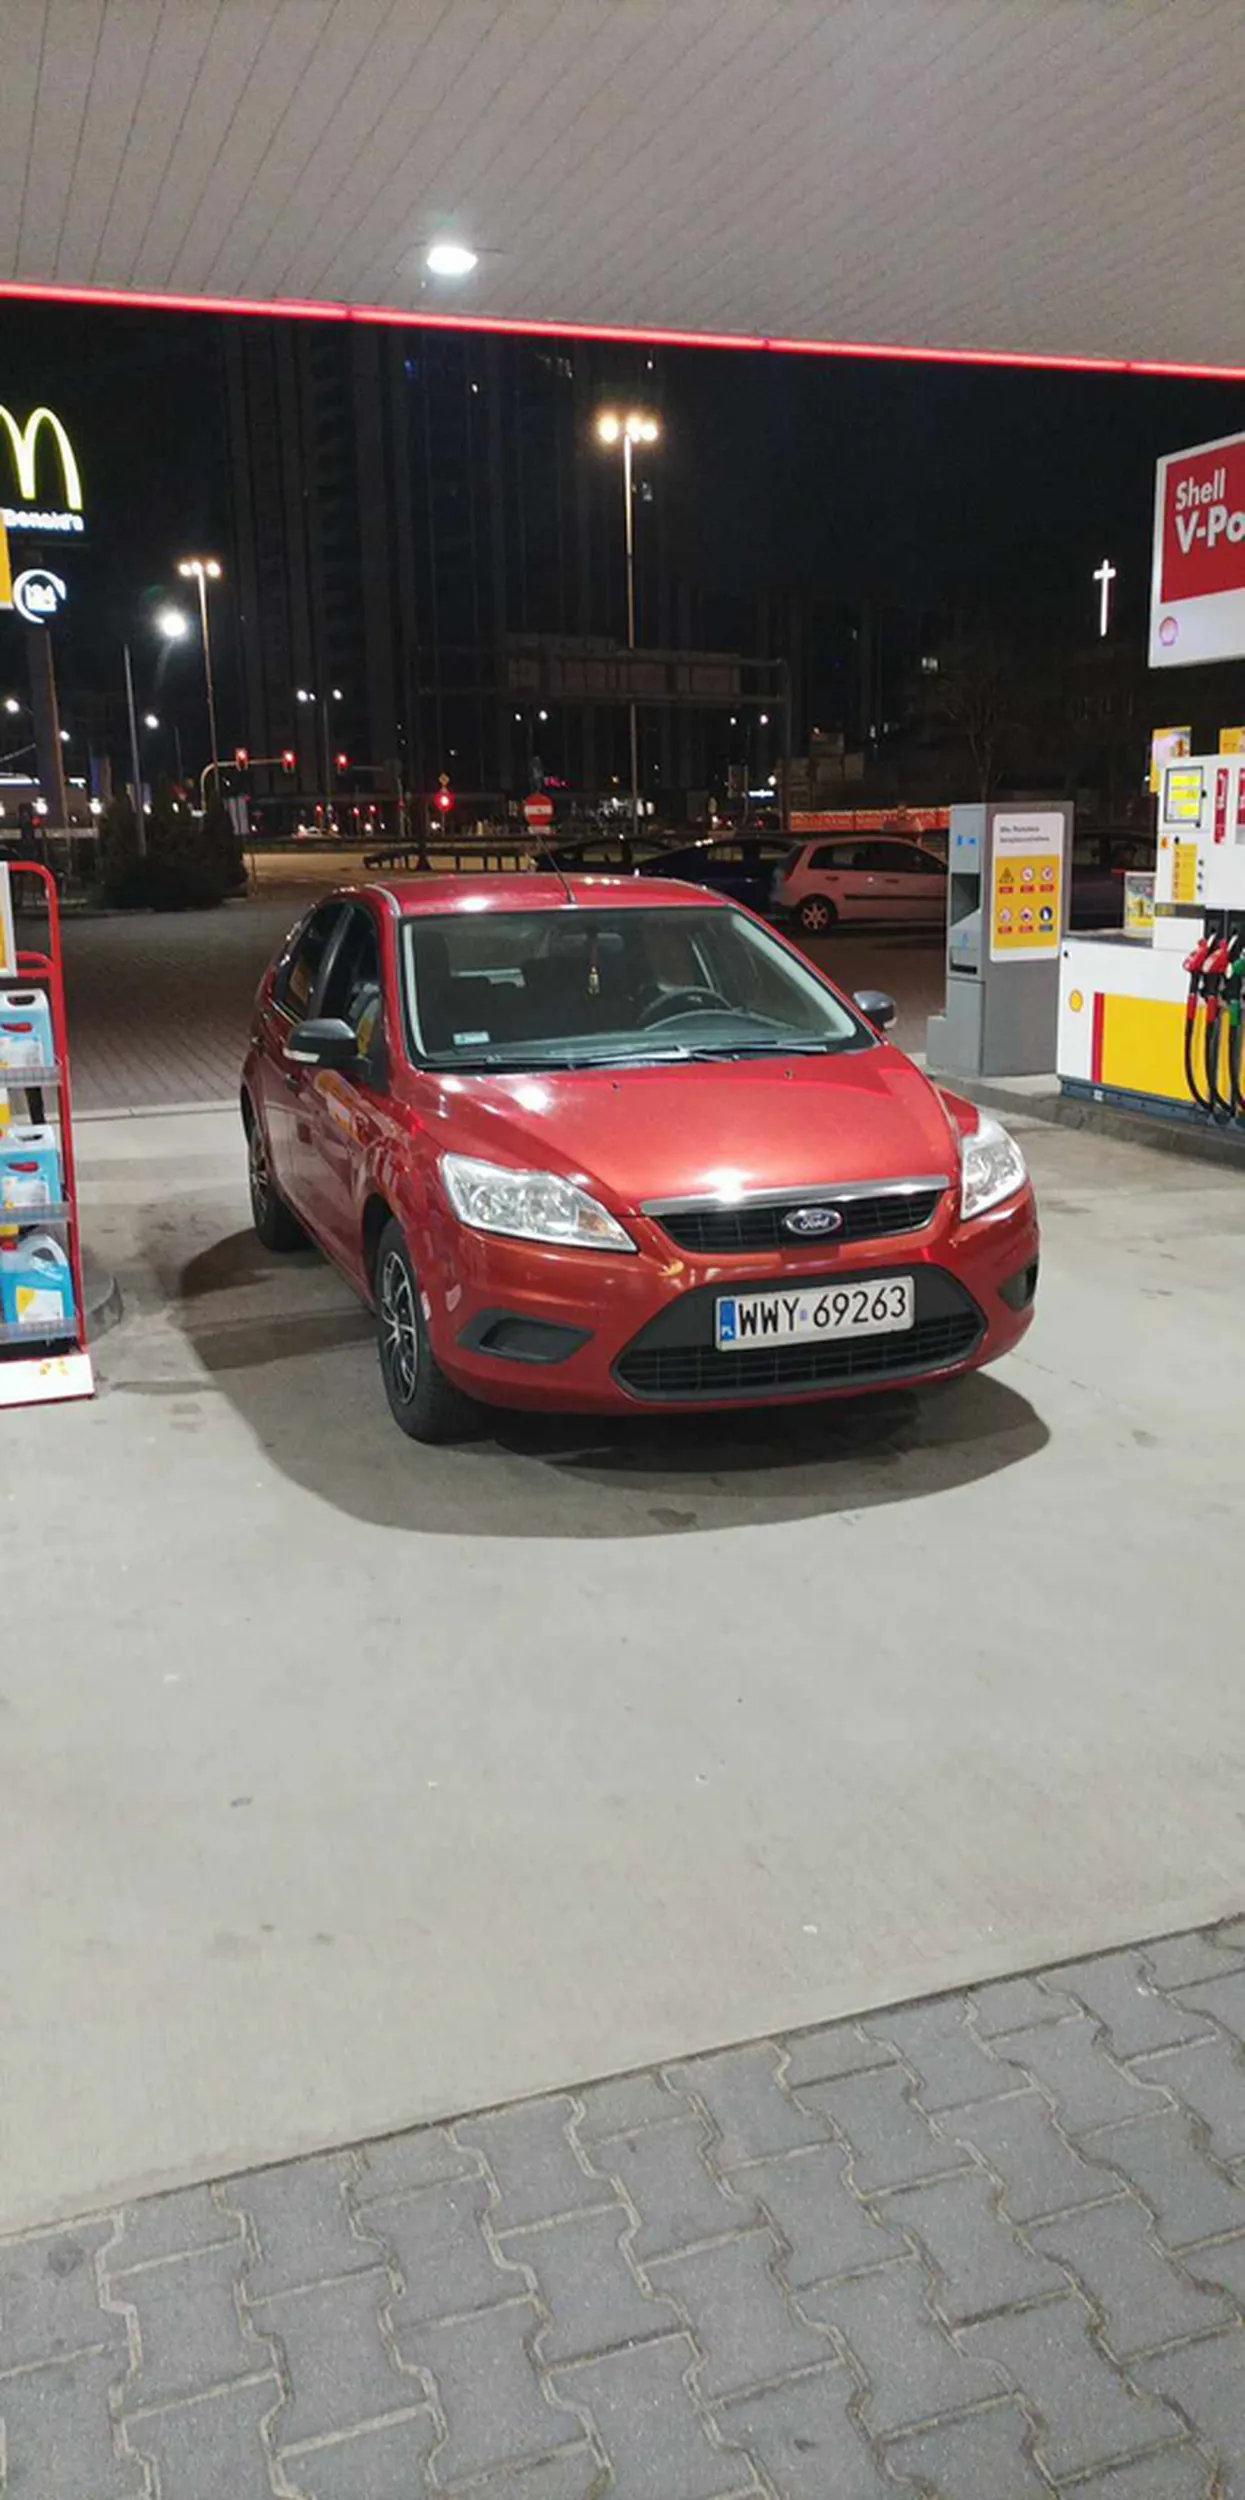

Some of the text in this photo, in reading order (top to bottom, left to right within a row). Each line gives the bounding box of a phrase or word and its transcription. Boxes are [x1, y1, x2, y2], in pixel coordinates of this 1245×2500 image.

[1175, 467, 1226, 511] Shell
[738, 1286, 906, 1336] WWY 69263
